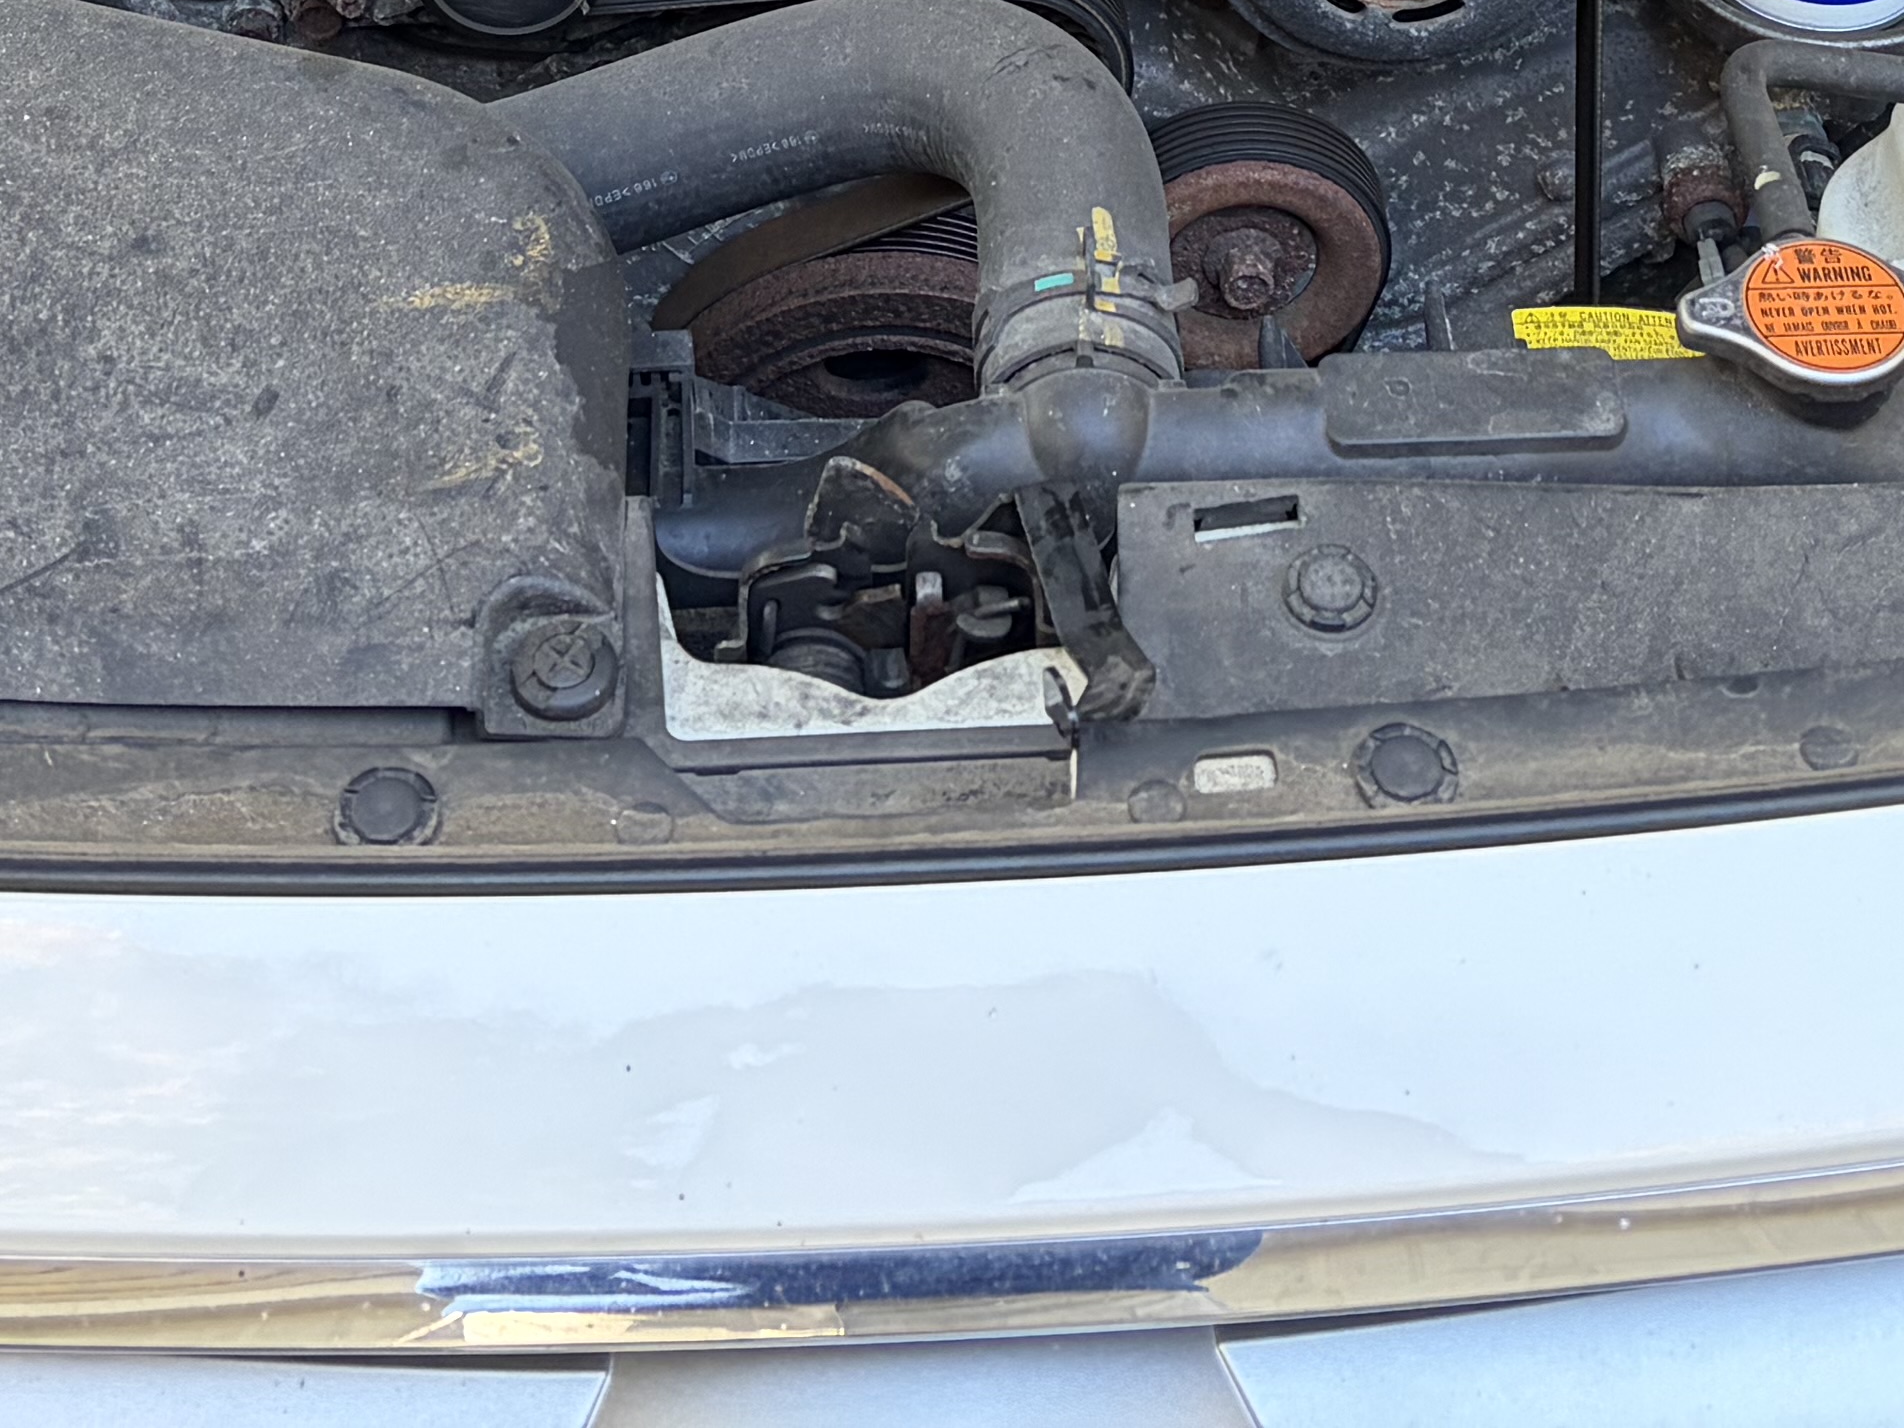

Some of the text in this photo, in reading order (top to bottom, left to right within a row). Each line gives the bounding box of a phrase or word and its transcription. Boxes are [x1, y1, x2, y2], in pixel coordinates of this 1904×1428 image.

[1797, 266, 1873, 283] WARNING
[1579, 311, 1630, 324] CAUTION
[1638, 315, 1674, 328] ATTEN
[1760, 304, 1898, 318] NEVER OPEN WHEN HOT.
[1764, 323, 1776, 333] NE
[1783, 322, 1814, 332] JAMAIS
[1795, 338, 1883, 357] AVERTISSMENT
